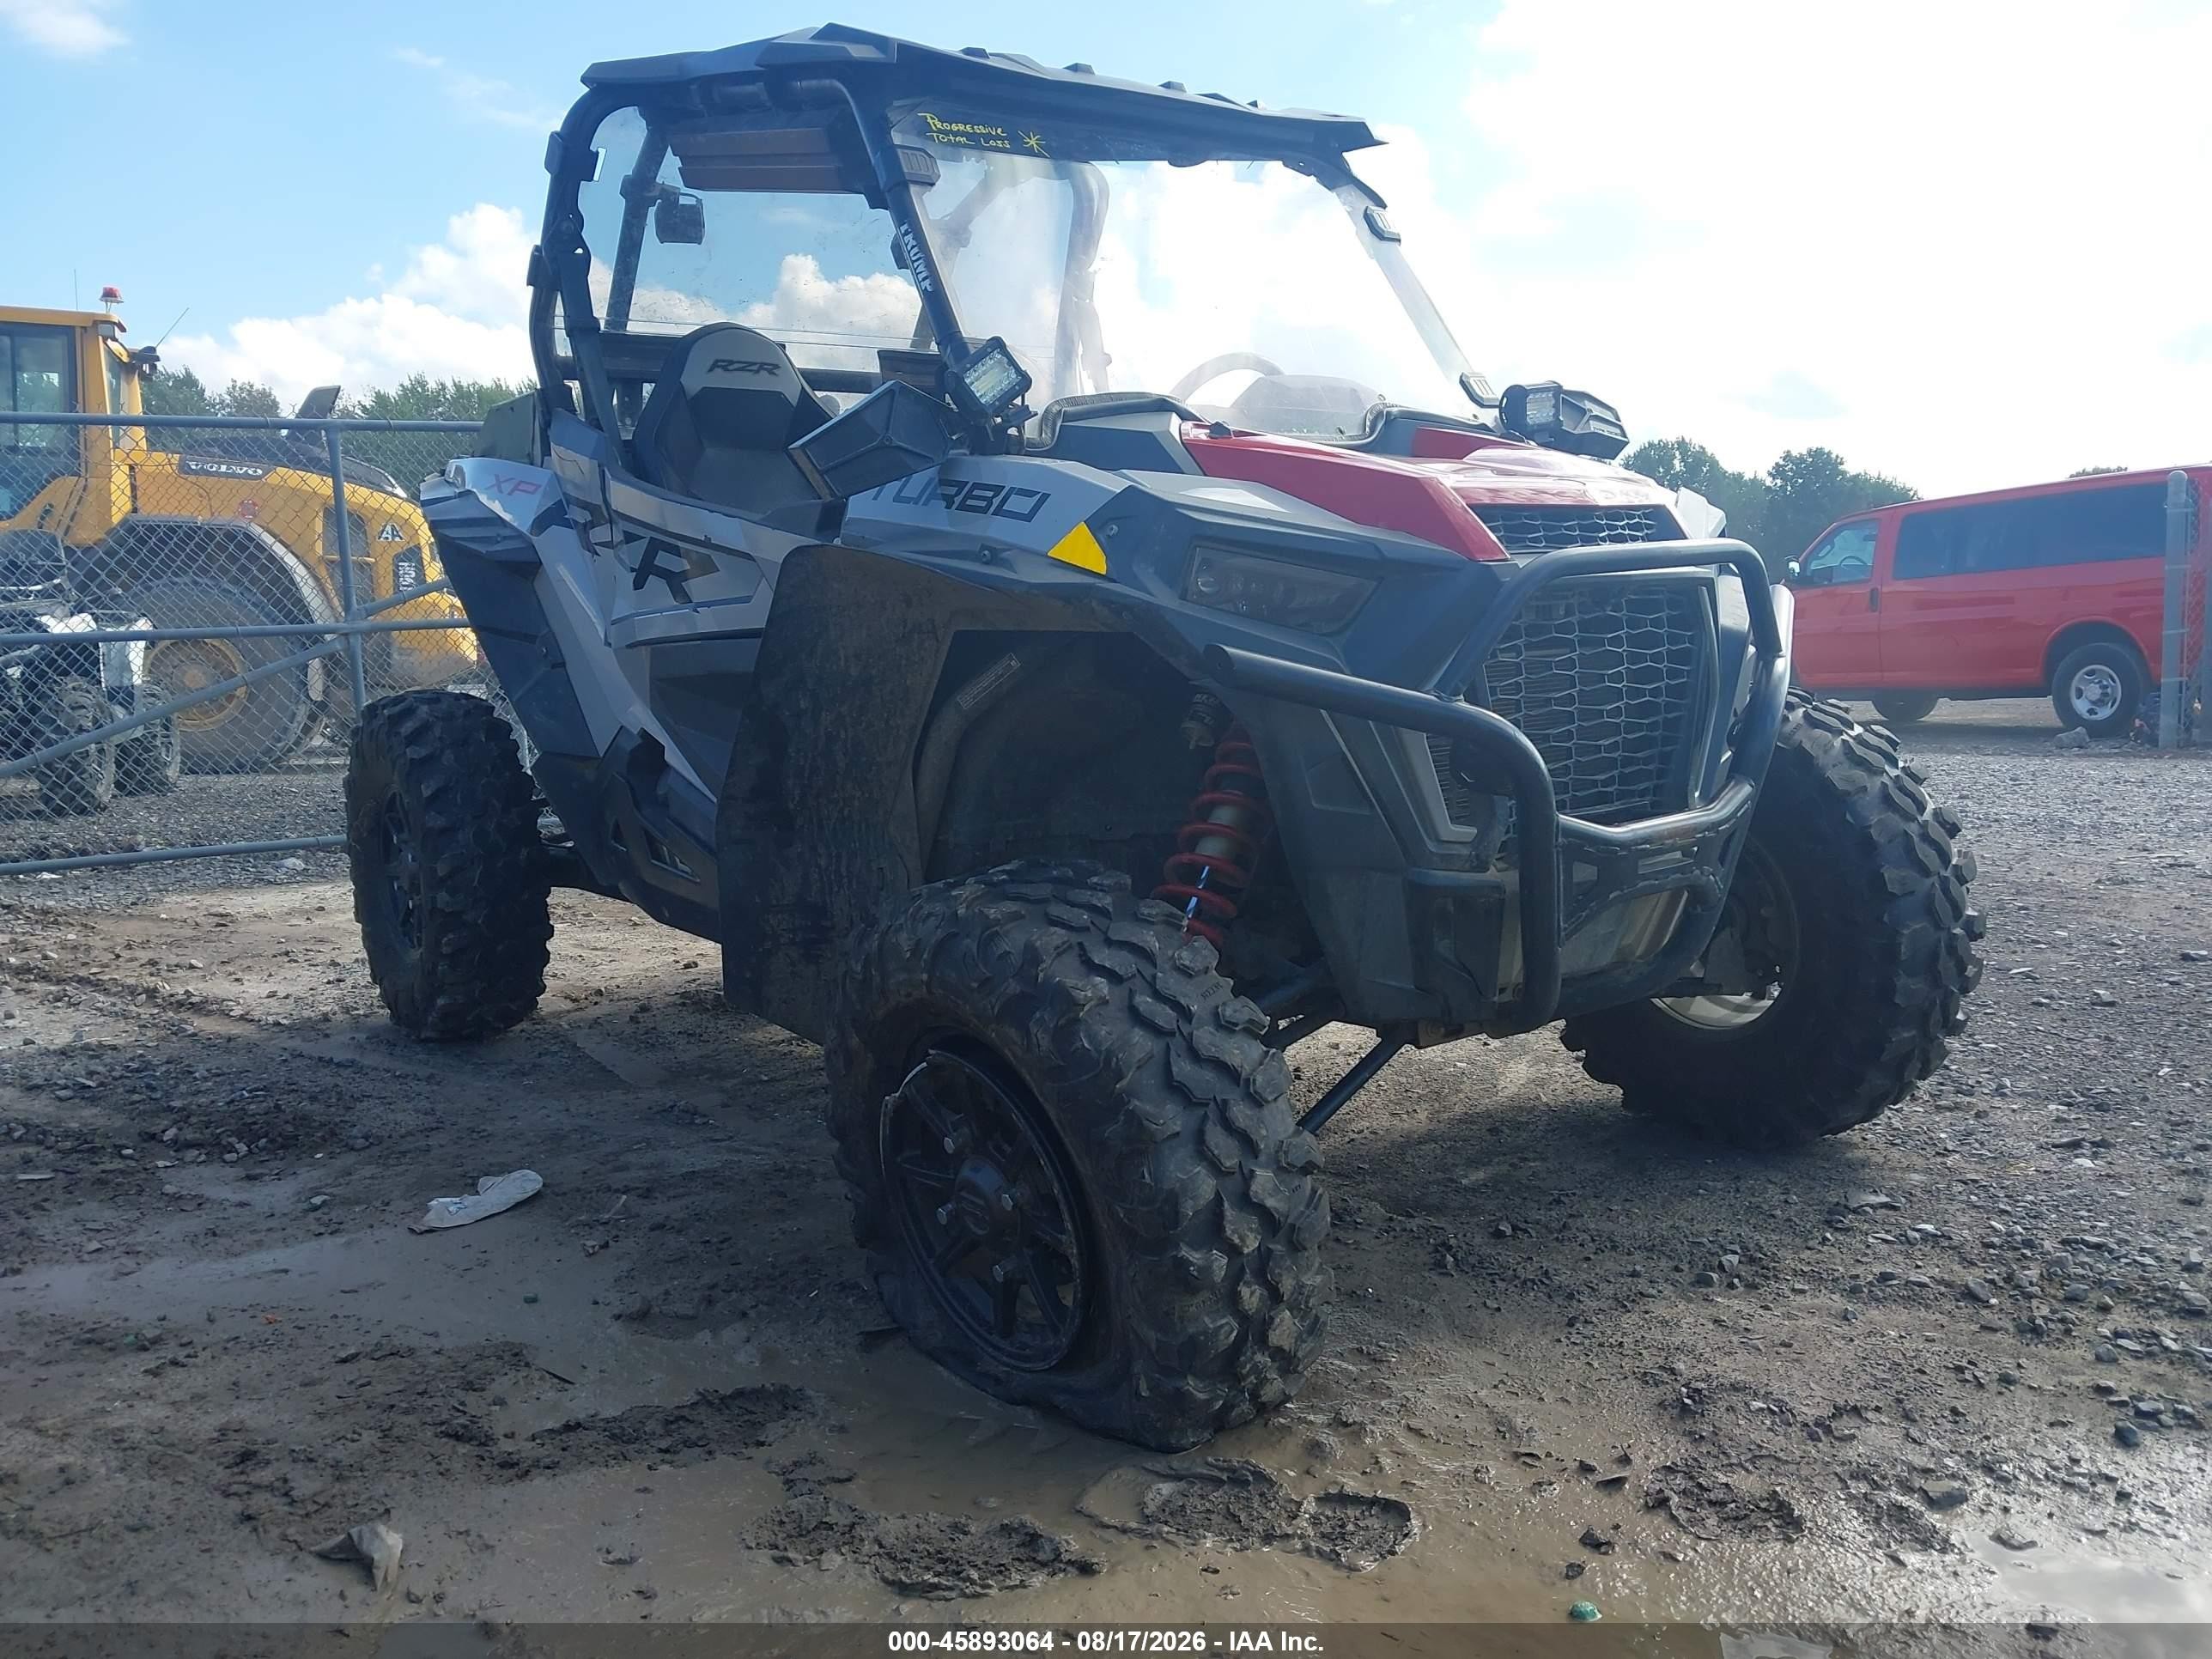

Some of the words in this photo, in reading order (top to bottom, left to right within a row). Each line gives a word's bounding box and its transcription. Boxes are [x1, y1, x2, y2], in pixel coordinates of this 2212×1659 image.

[898, 220, 934, 292] TRUMP
[707, 358, 782, 377] RZR
[185, 460, 263, 476] VOLVO
[485, 473, 542, 495] XP
